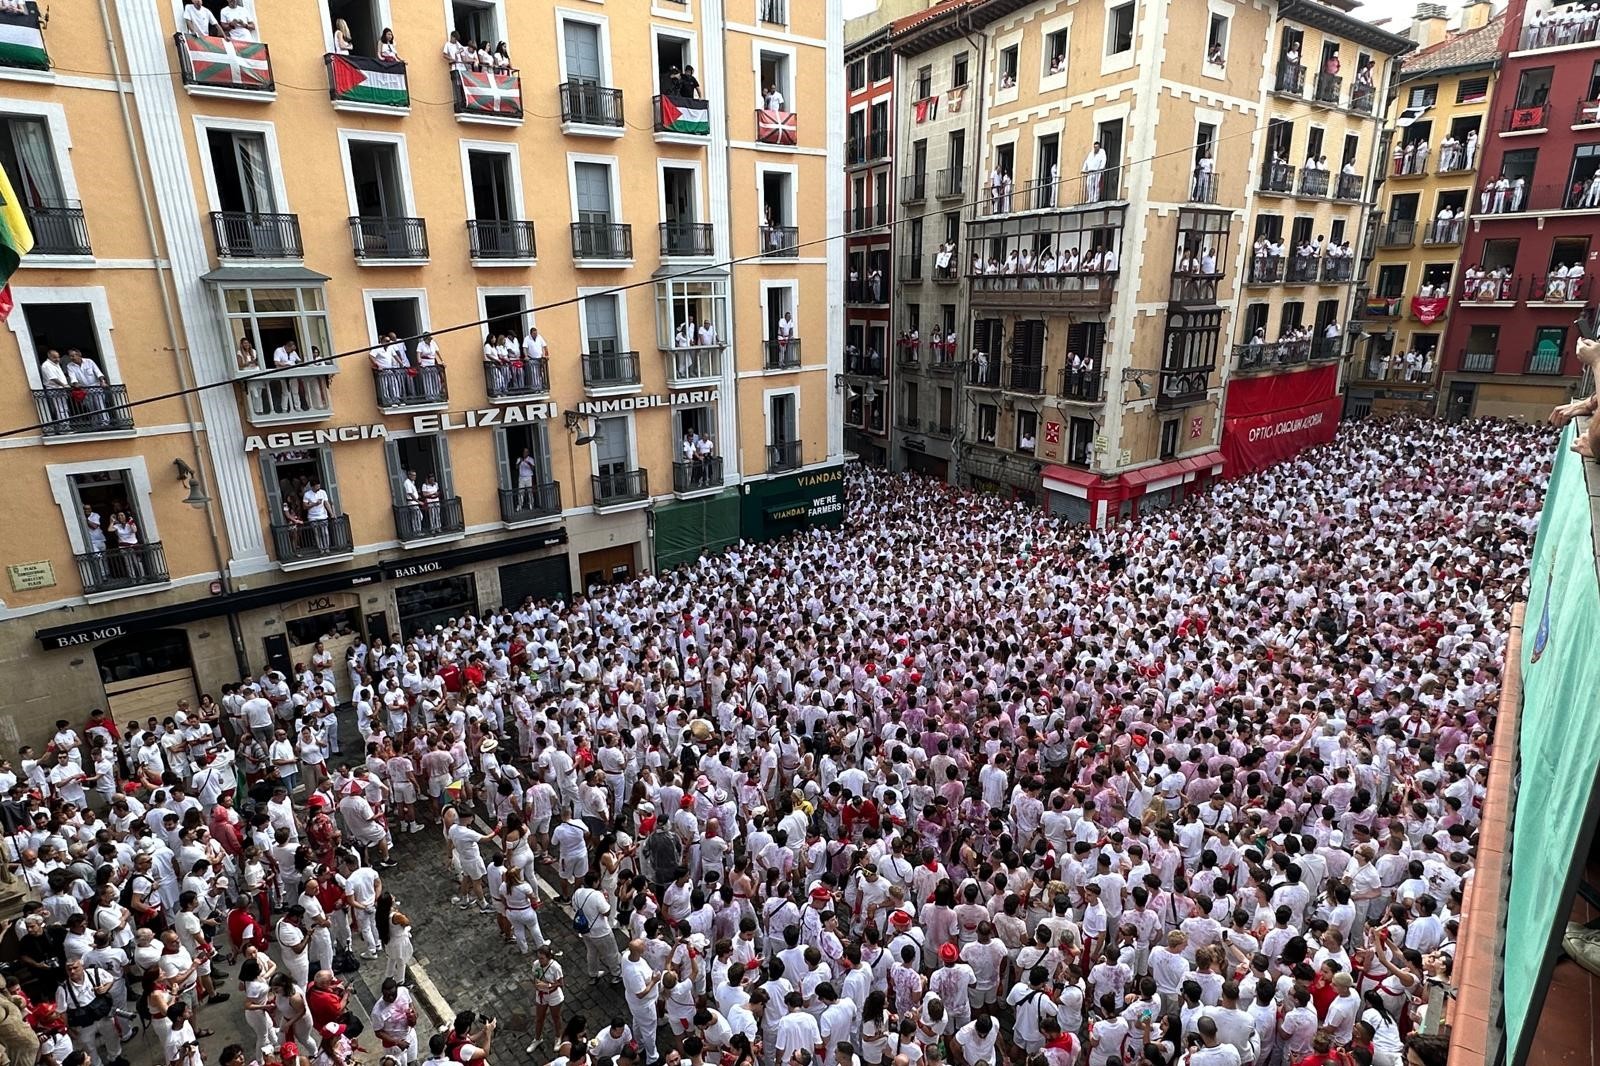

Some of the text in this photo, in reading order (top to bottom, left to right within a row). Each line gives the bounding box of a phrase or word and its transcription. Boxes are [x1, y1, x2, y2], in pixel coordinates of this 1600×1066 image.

[245, 390, 720, 452] AGENCIA ELIZARI INMOBILIARIA
[797, 470, 842, 487] VIANDAS
[813, 494, 837, 507] WE'RE
[773, 507, 806, 519] VIANDAS
[808, 503, 842, 517] FARMERS
[395, 561, 442, 578] BAR MOL
[308, 597, 335, 612] MOL
[56, 626, 127, 647] BAR MOL
